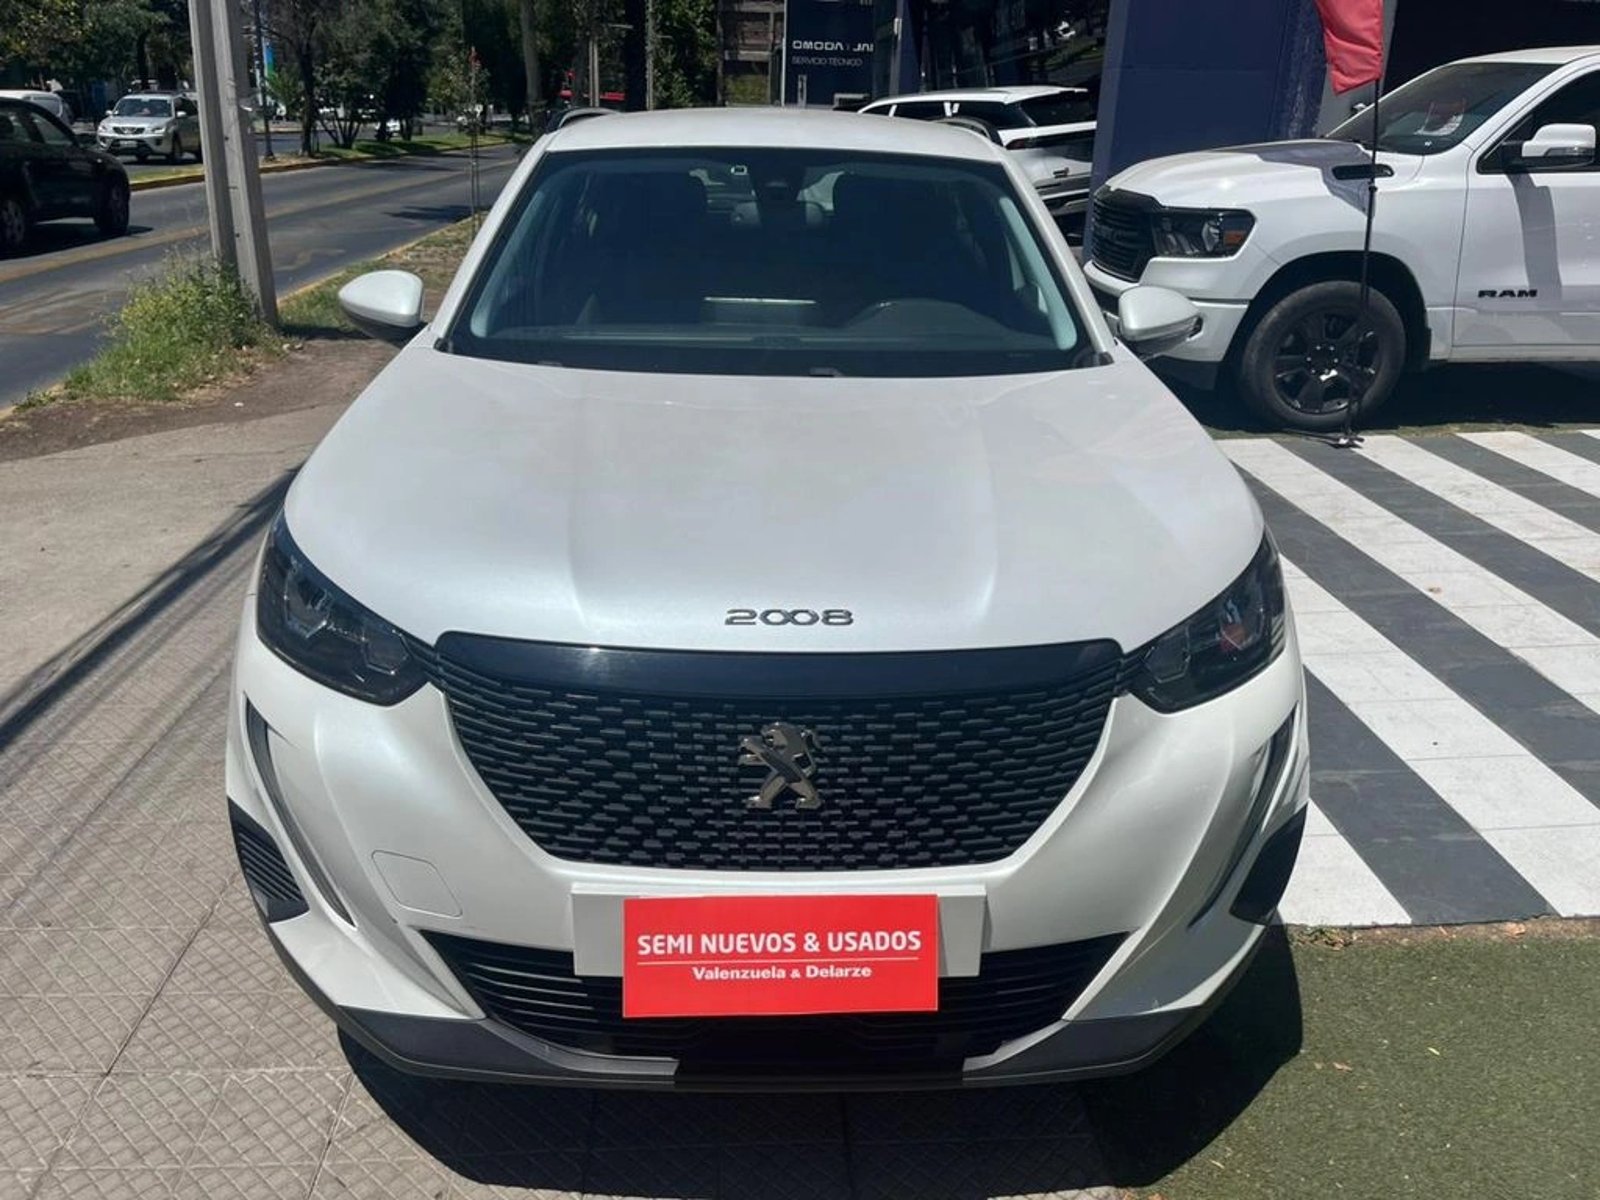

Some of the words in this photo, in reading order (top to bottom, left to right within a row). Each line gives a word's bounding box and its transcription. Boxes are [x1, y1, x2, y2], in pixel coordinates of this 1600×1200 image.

[792, 40, 844, 51] OMODA
[791, 56, 827, 65] SERVICIO
[1478, 289, 1537, 298] RAM
[725, 609, 854, 626] 2008
[637, 934, 693, 955] SEMI
[700, 932, 796, 954] NUEVOS
[802, 931, 820, 953] &
[827, 930, 922, 951] USADOS
[692, 966, 786, 980] Valenzuela
[790, 969, 801, 979] &
[805, 964, 873, 979] Delarze
